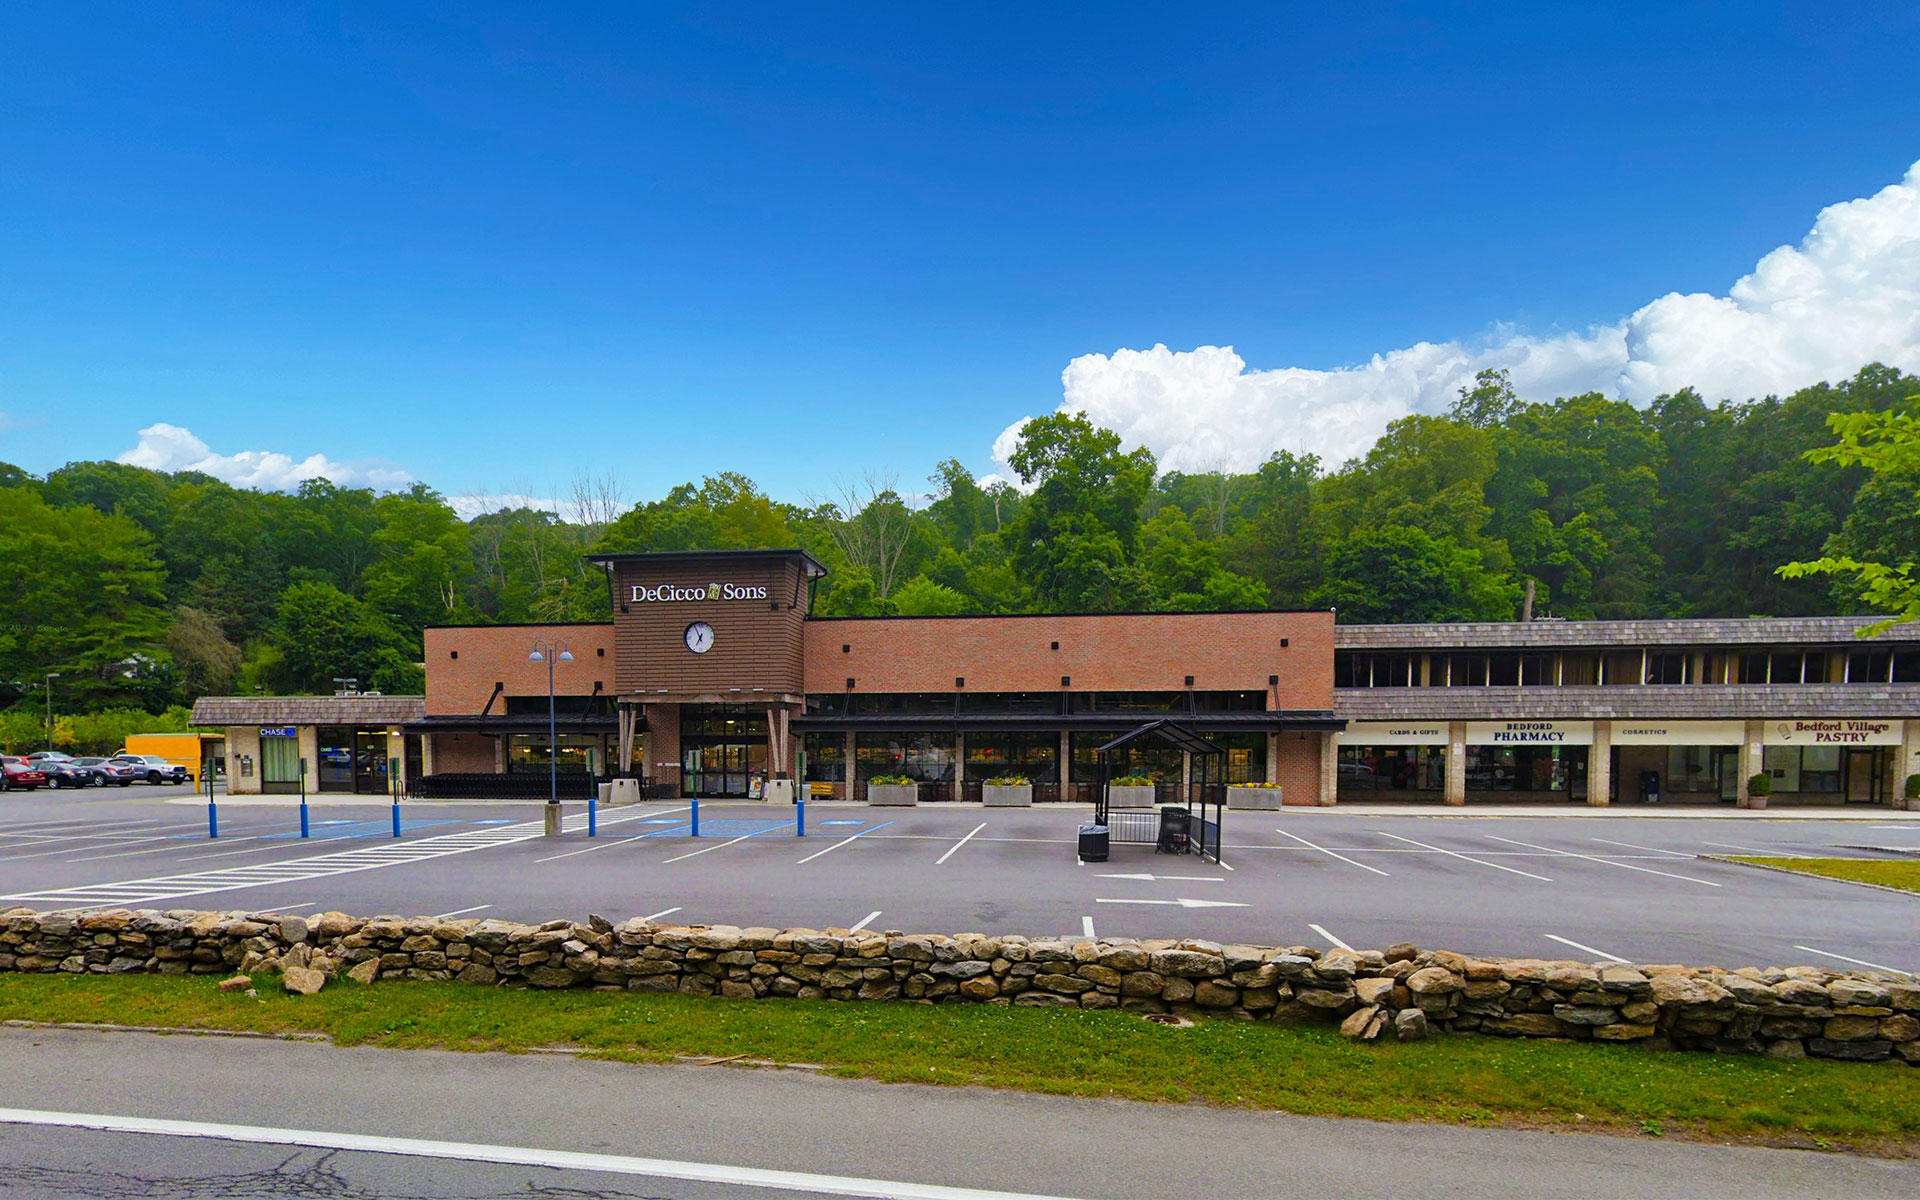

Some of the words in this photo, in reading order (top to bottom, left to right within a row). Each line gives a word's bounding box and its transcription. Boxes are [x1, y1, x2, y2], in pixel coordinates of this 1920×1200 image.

[631, 584, 706, 602] DeCicco
[723, 583, 767, 600] Sons
[1506, 723, 1553, 731] BEDFORD
[1795, 721, 1842, 732] Bedford
[1846, 721, 1890, 734] Village
[260, 728, 286, 736] CHASE
[1493, 732, 1565, 741] PHARMACY
[1815, 732, 1870, 742] PASTRY
